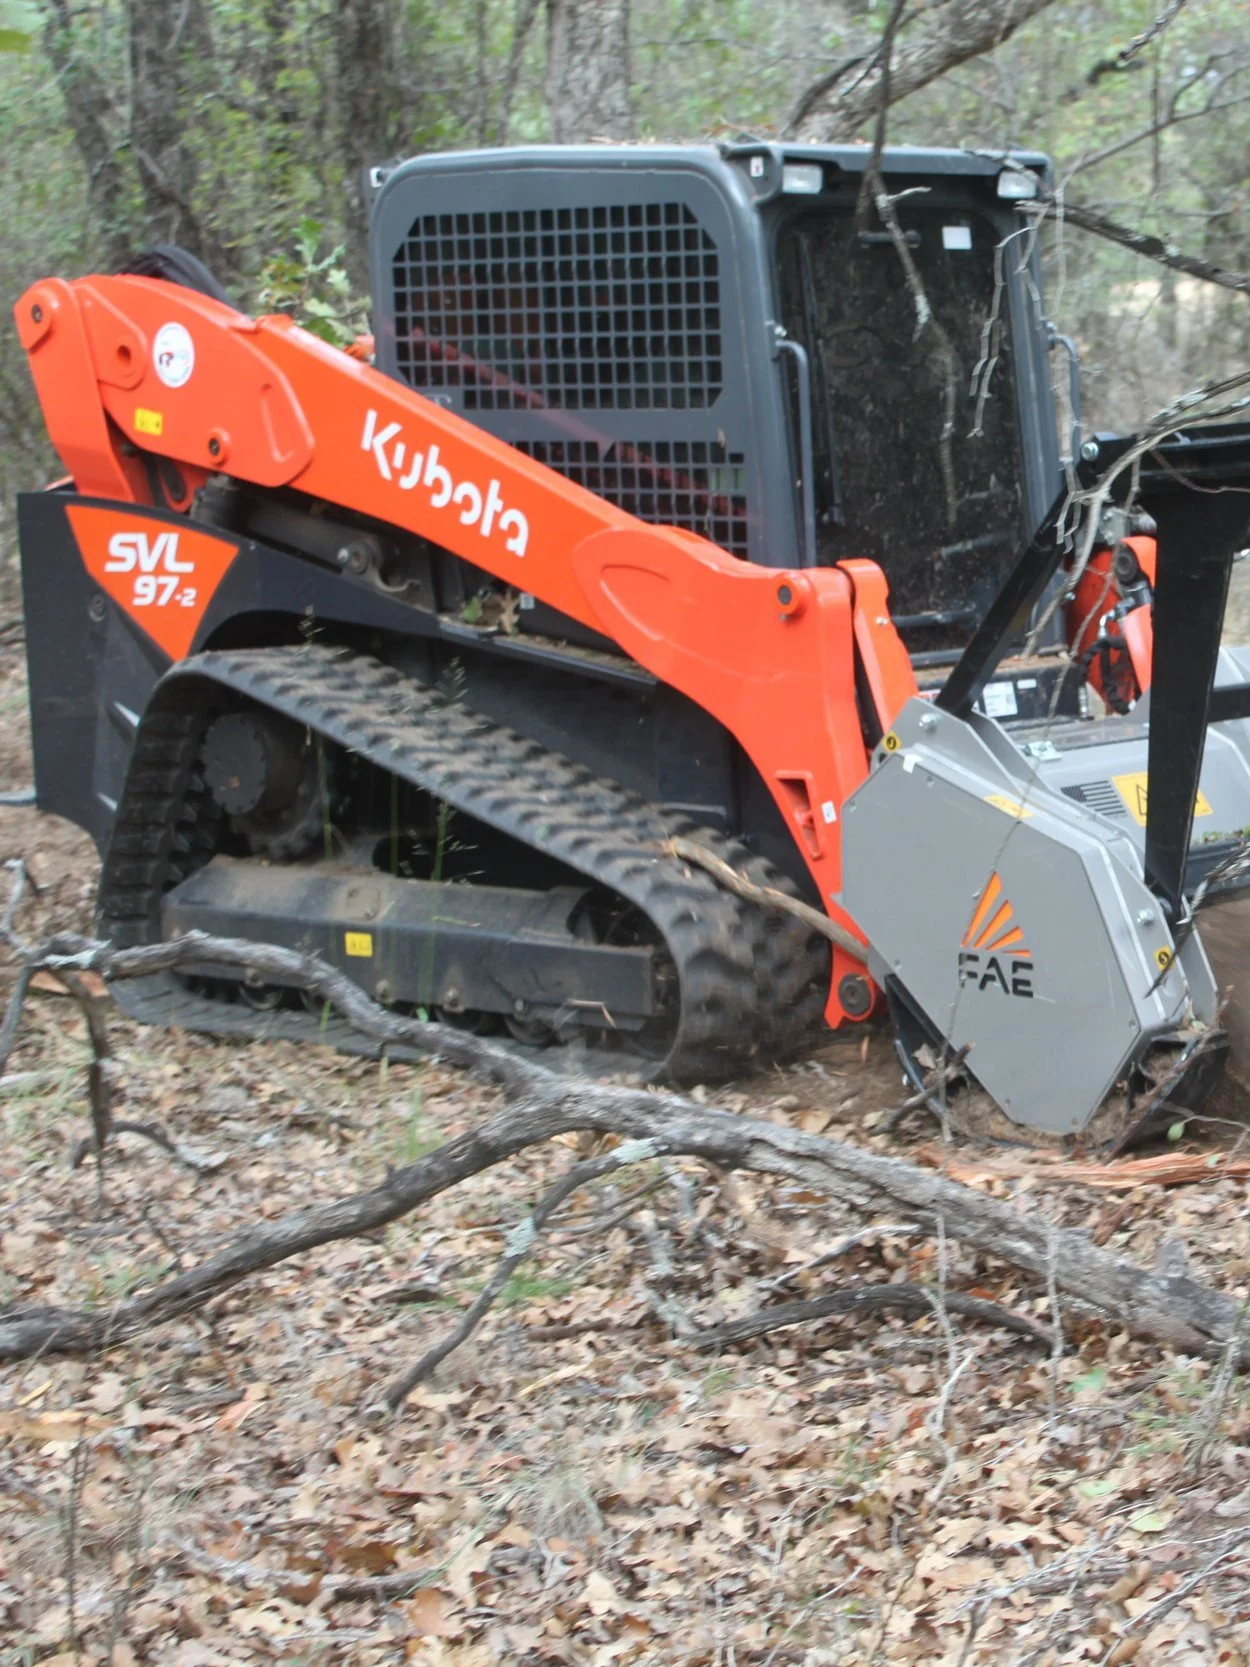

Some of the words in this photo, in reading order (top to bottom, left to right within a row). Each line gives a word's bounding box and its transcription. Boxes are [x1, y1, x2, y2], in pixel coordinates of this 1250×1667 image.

[361, 409, 529, 558] Kubota
[104, 532, 196, 573] SVL
[132, 575, 198, 607] 97-2
[958, 952, 1034, 998] FAE
